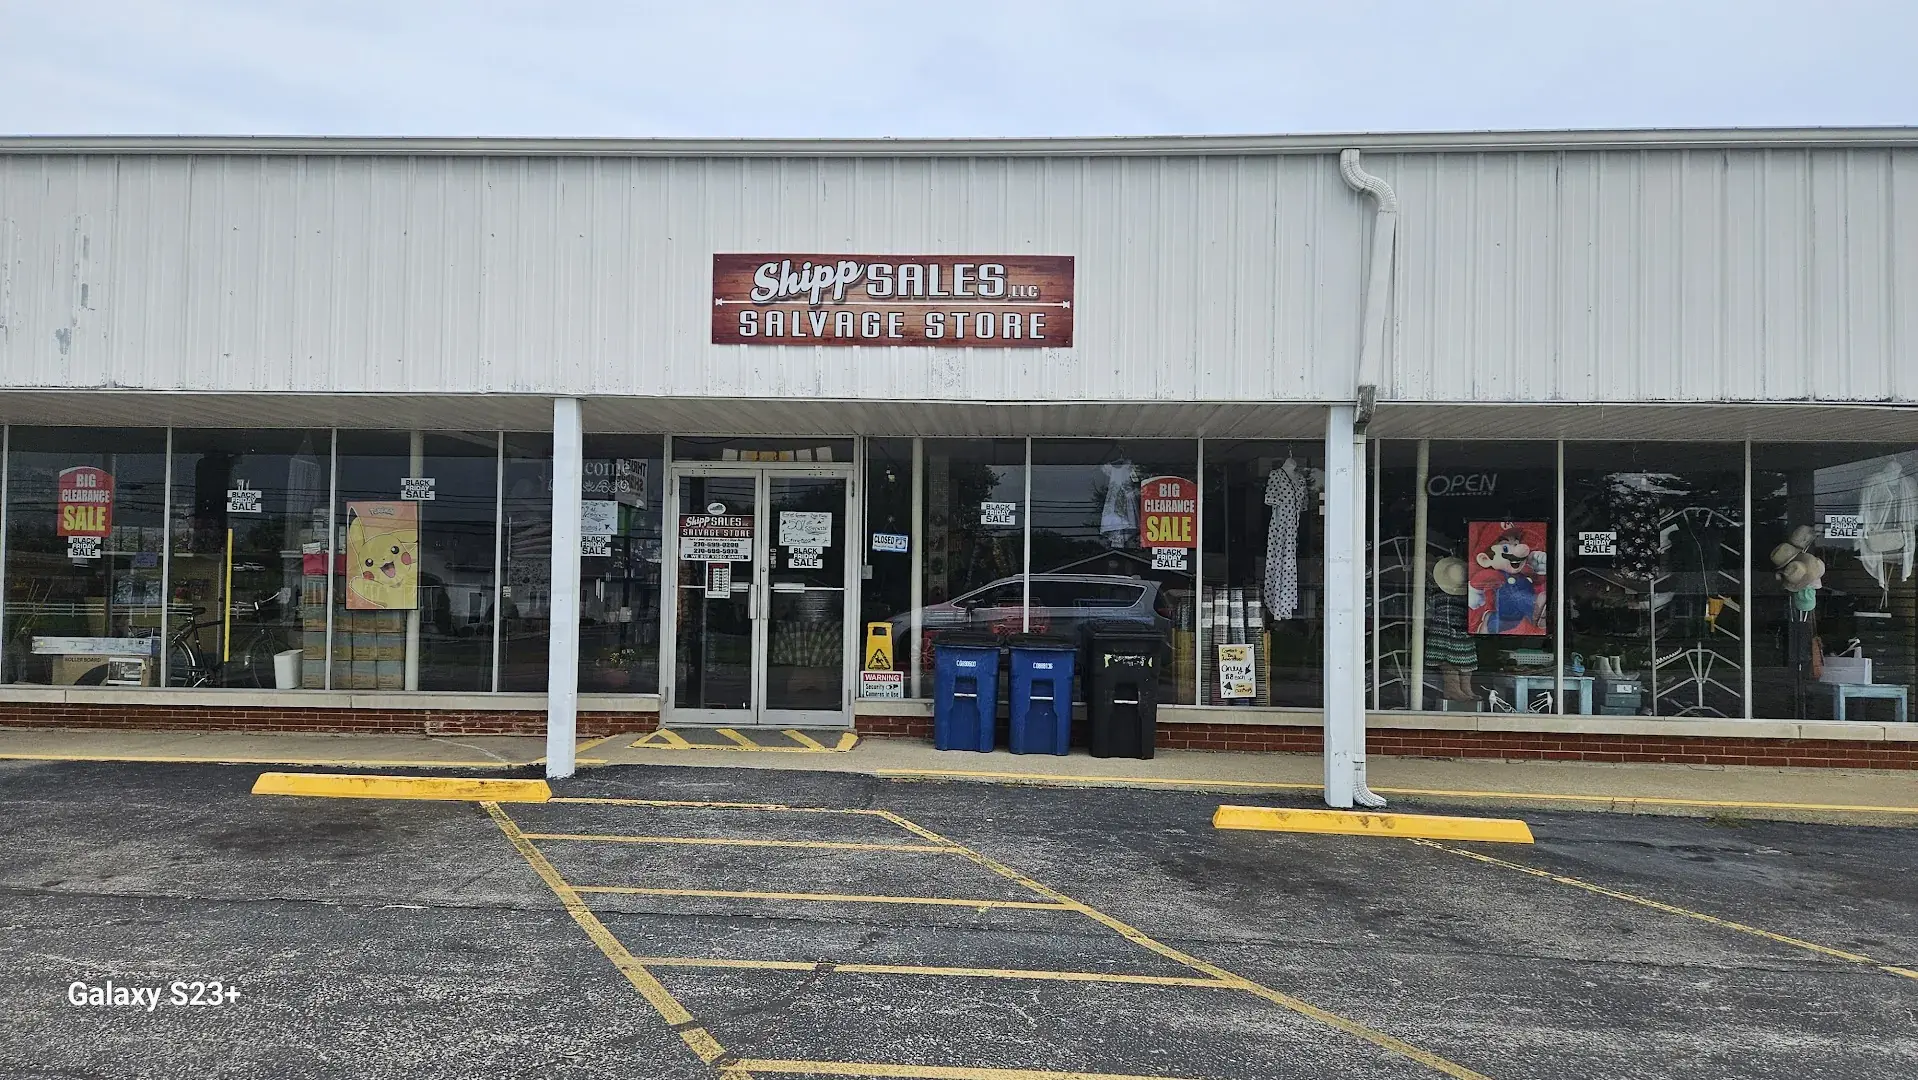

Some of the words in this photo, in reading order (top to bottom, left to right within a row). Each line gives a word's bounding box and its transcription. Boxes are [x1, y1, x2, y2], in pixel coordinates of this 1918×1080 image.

[750, 259, 865, 305] Shipp
[866, 263, 1005, 297] SALES
[739, 311, 904, 338] SALVAGE
[925, 312, 1046, 340] STORE
[76, 473, 97, 488] BIG
[1427, 473, 1498, 496] OPEN
[405, 491, 430, 499] SALE
[1159, 483, 1180, 498] BIG
[62, 488, 110, 503] CLEARANCE
[232, 503, 256, 511] SALE
[1144, 499, 1195, 513] CLEARANCE
[63, 505, 106, 532] SALE
[685, 516, 710, 528] Shipp
[711, 516, 742, 527] SALES
[986, 515, 1010, 523] SALE
[682, 528, 720, 536] SALVAGE
[723, 529, 750, 537] STORE
[1146, 515, 1192, 542] SALE
[1830, 529, 1858, 537] SALE
[874, 535, 895, 545] CLOSED
[72, 549, 96, 557] SALE
[581, 547, 606, 555] SALE
[1584, 545, 1611, 553] SALE
[793, 559, 818, 567] SALE
[1156, 560, 1182, 568] SALE
[865, 673, 900, 681] WARNING
[865, 683, 885, 691] Security
